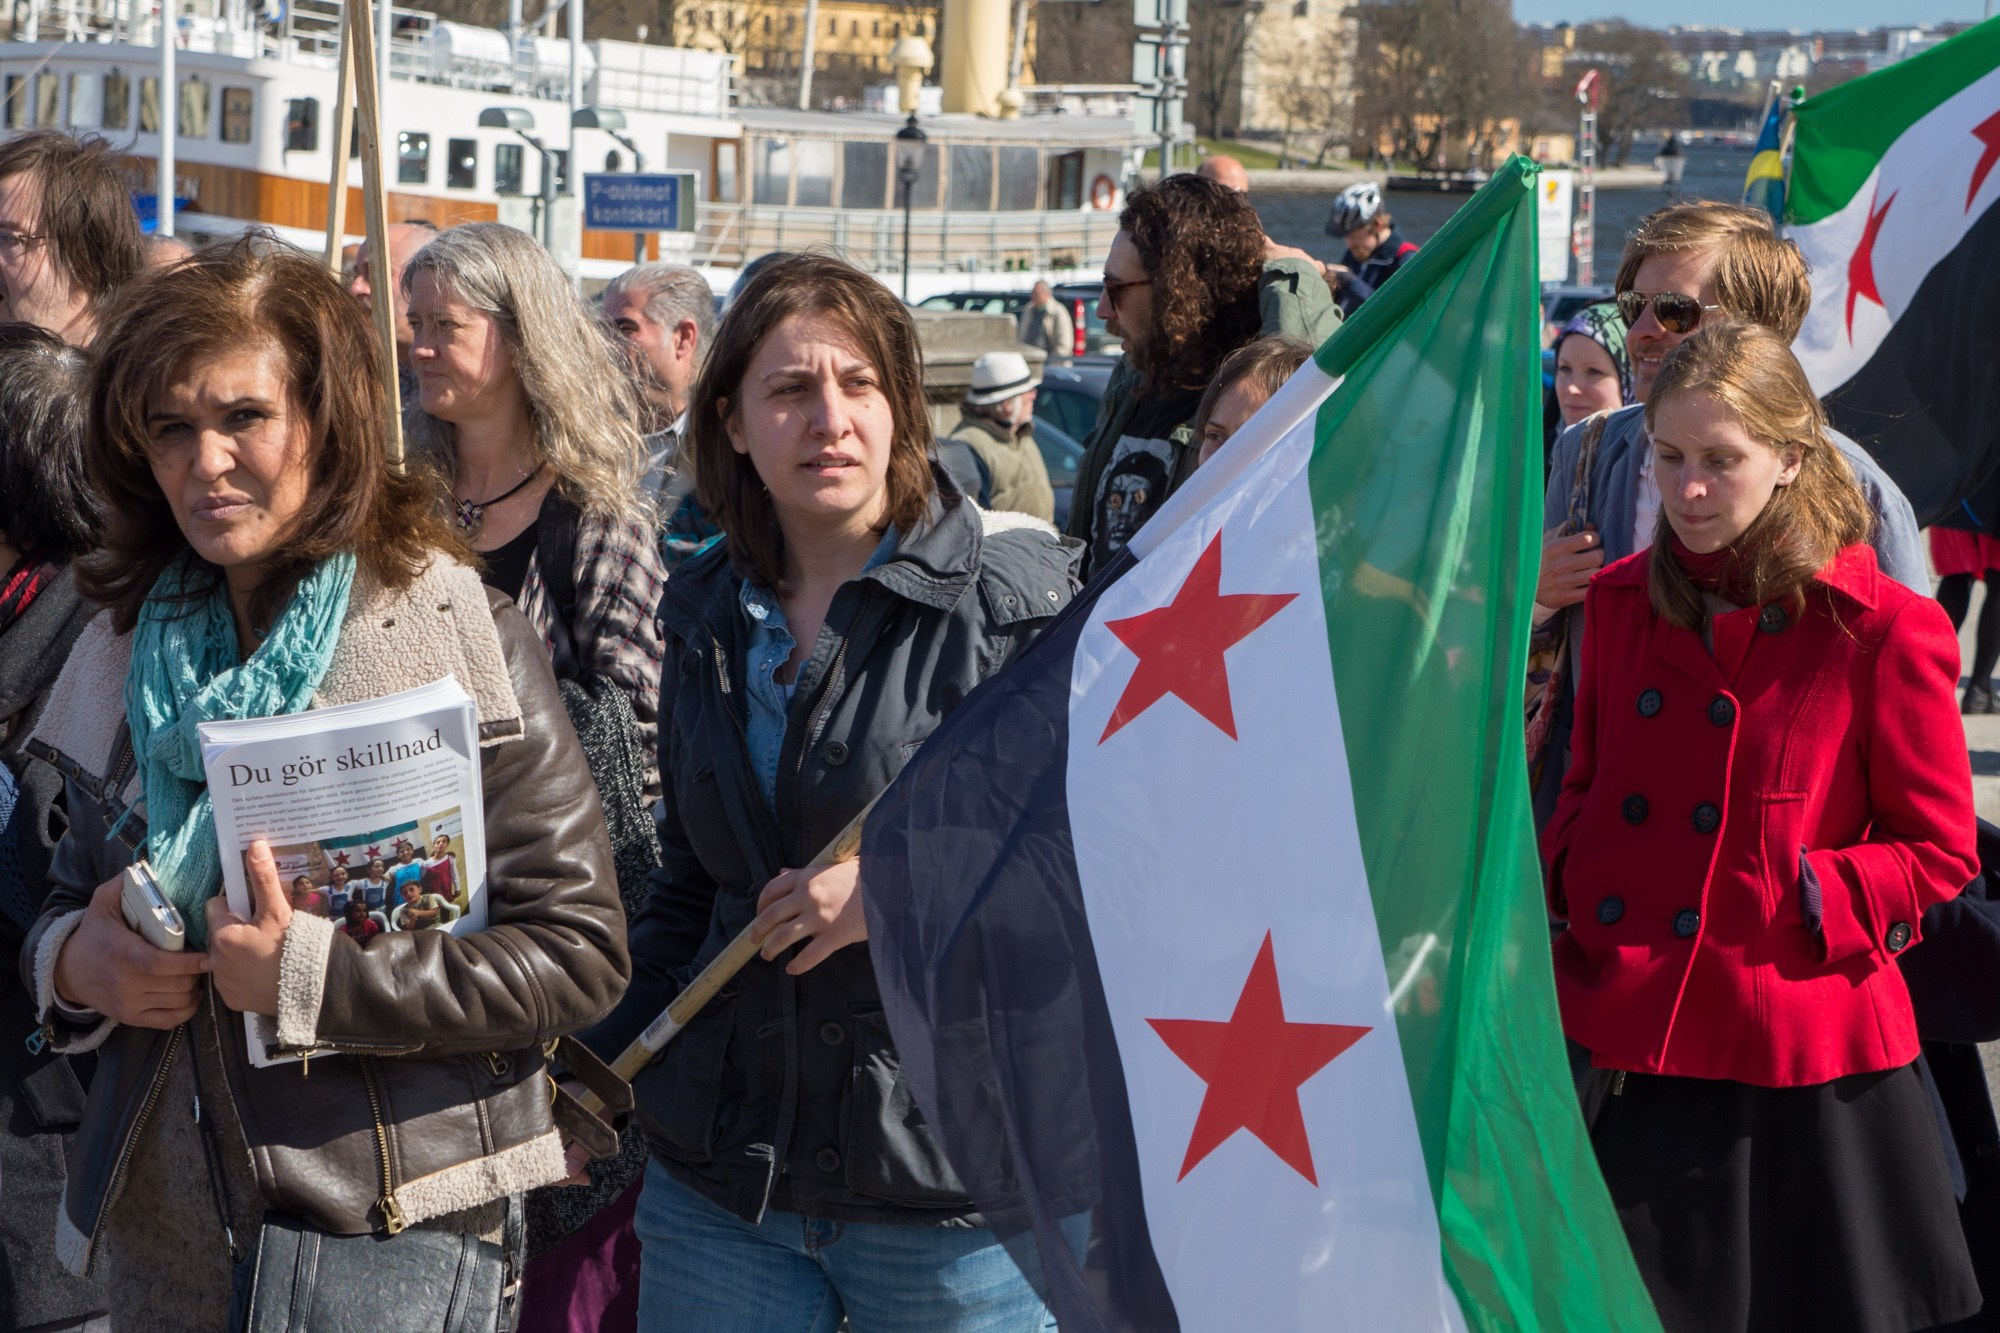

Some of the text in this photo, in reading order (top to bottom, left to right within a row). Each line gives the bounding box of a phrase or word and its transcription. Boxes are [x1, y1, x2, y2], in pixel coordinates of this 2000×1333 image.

[591, 180, 671, 201] P-automat
[592, 204, 670, 224] kontokort
[228, 728, 442, 787] Du gör skillnad
